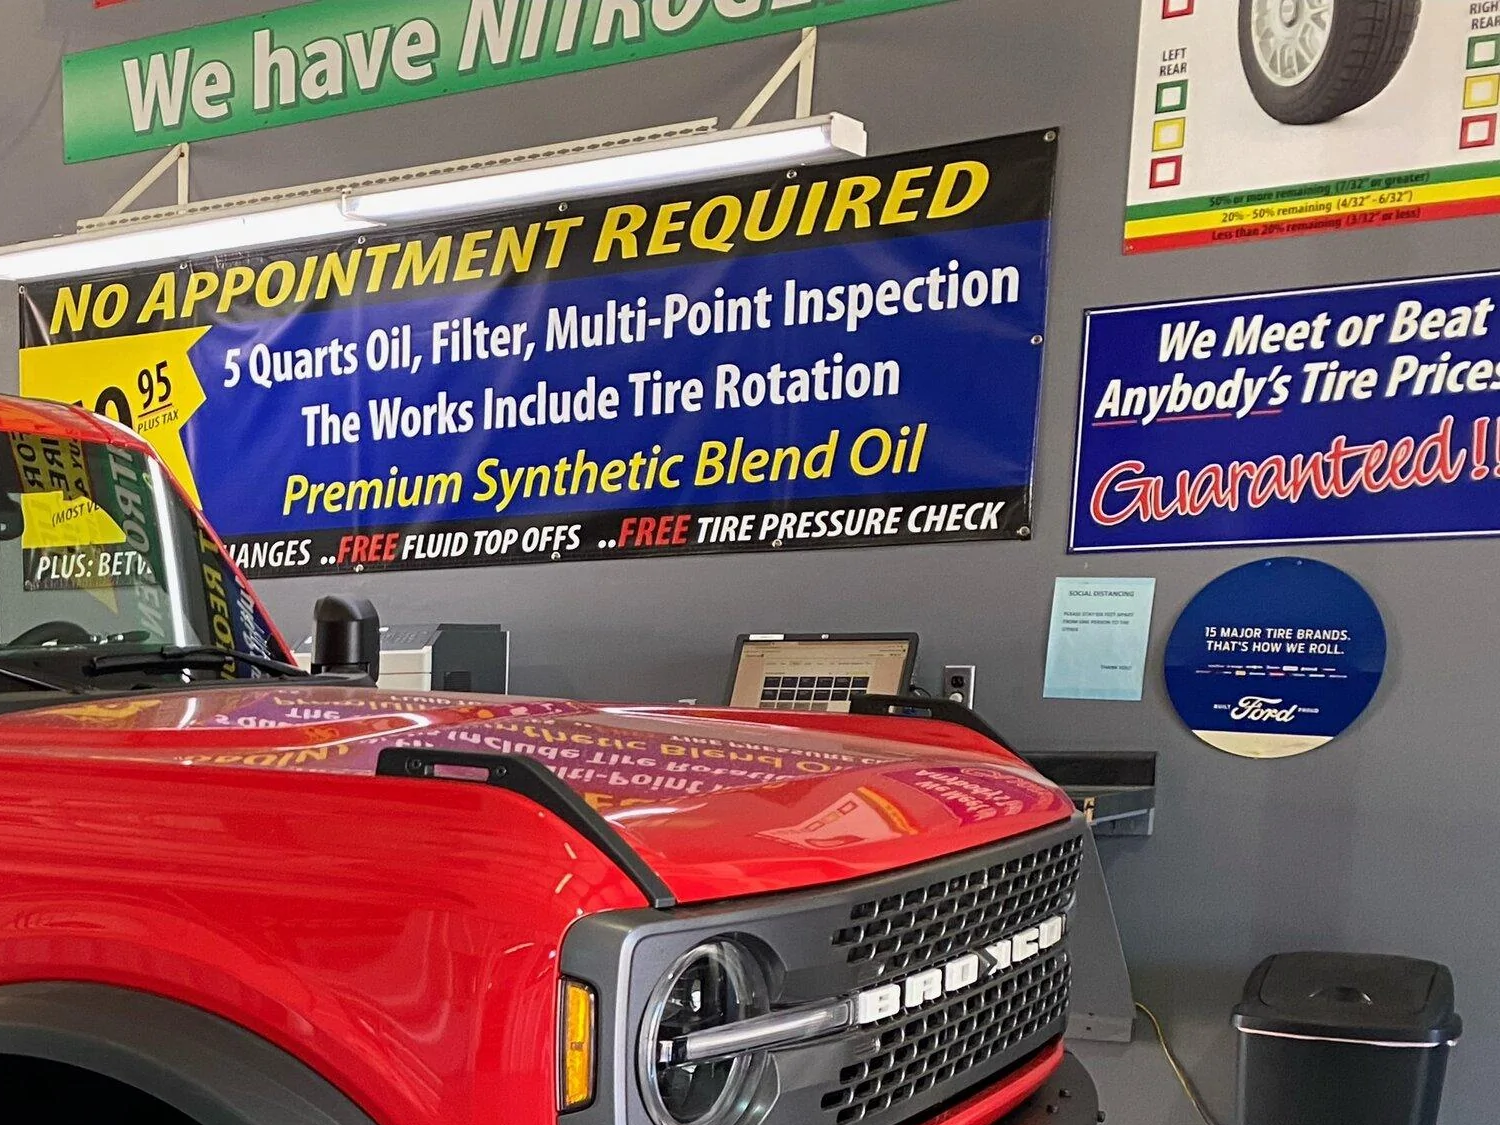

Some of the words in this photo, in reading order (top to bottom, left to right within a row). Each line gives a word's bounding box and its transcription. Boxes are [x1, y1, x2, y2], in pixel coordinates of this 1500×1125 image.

[1470, 1, 1499, 15] RIGH
[1160, 62, 1187, 76] REAR
[1163, 47, 1187, 61] LEFT
[122, 48, 231, 132] We
[253, 19, 438, 110] have
[1209, 195, 1232, 208] 50%
[1246, 192, 1274, 203] more
[1276, 185, 1331, 199] remaining
[1371, 177, 1383, 187] or
[1385, 172, 1430, 188] greater)
[1212, 230, 1232, 241] Less
[1235, 226, 1259, 237] than
[1261, 223, 1285, 235] 20%
[1286, 218, 1341, 231] remaining
[1395, 207, 1421, 219] less)
[1222, 211, 1244, 223] 20%
[1252, 208, 1275, 220] 50%
[1277, 200, 1332, 216] remaining
[50, 282, 128, 335] NO
[137, 215, 585, 323] APPOINTMENT
[592, 160, 990, 263] REQUIRED
[223, 347, 241, 388] 5
[248, 337, 358, 392] Quarts
[366, 327, 422, 375] Oil,
[431, 314, 536, 363] Filter,
[544, 285, 770, 353] Multi-Point
[784, 259, 1021, 333] Inspection
[1158, 320, 1216, 363] We
[1222, 314, 1330, 358] Meet
[1337, 312, 1385, 348] or
[1389, 298, 1495, 345] Beat
[137, 360, 172, 410] 95
[301, 402, 361, 447] The
[369, 391, 474, 440] Works
[483, 376, 620, 432] Include
[628, 368, 704, 418] Tire
[715, 352, 900, 410] Rotation
[1094, 364, 1292, 426] Anybody's
[1300, 360, 1378, 404] Tire
[137, 415, 160, 433] PLUS
[161, 409, 179, 425] TAX
[282, 465, 462, 516] Premium
[472, 444, 685, 513] Synthetic
[693, 430, 840, 487] Blend
[849, 422, 928, 476] Oil
[401, 532, 470, 560] FLUID
[473, 529, 519, 556] TOP
[521, 524, 582, 552] OFFS
[698, 514, 756, 544] TIRE
[758, 507, 903, 540] PRESSURE
[907, 501, 1006, 533] CHECK
[37, 553, 94, 581] PLUS:
[1205, 627, 1217, 637] 15
[1220, 627, 1262, 639] MAJOR
[1266, 628, 1293, 640] TIRE
[1296, 629, 1351, 641] BRANDS.
[1206, 640, 1248, 652] THAT'S
[1252, 642, 1282, 653] HOW
[1286, 642, 1305, 653] WE
[1309, 642, 1345, 655] ROLL.
[1230, 696, 1298, 722] Ford
[858, 915, 1063, 1025] BRONCO
